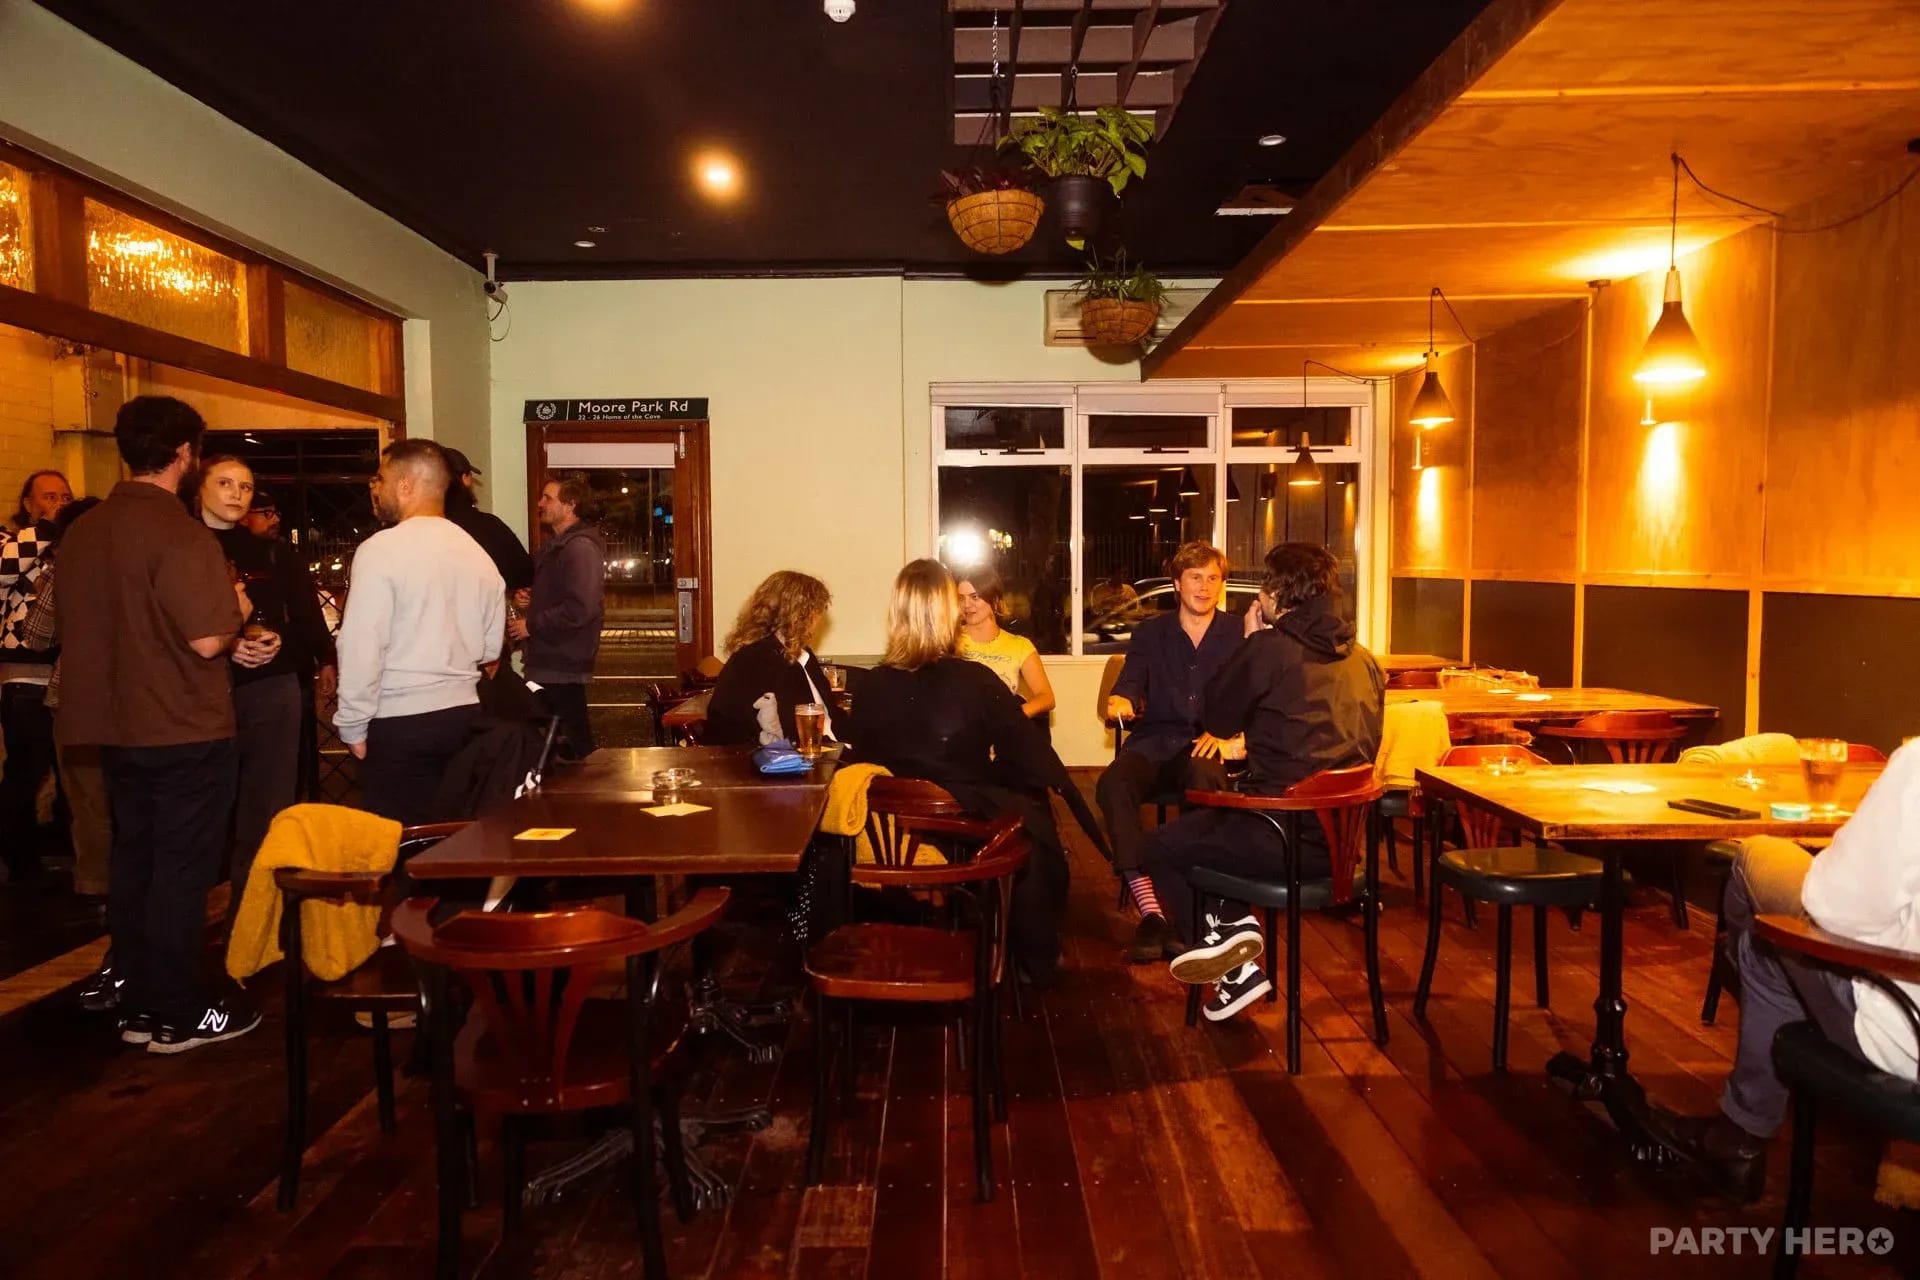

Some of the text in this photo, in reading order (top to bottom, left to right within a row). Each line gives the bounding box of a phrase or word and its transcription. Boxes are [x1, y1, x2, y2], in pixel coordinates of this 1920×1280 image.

[578, 400, 688, 413] Moore Park Rd
